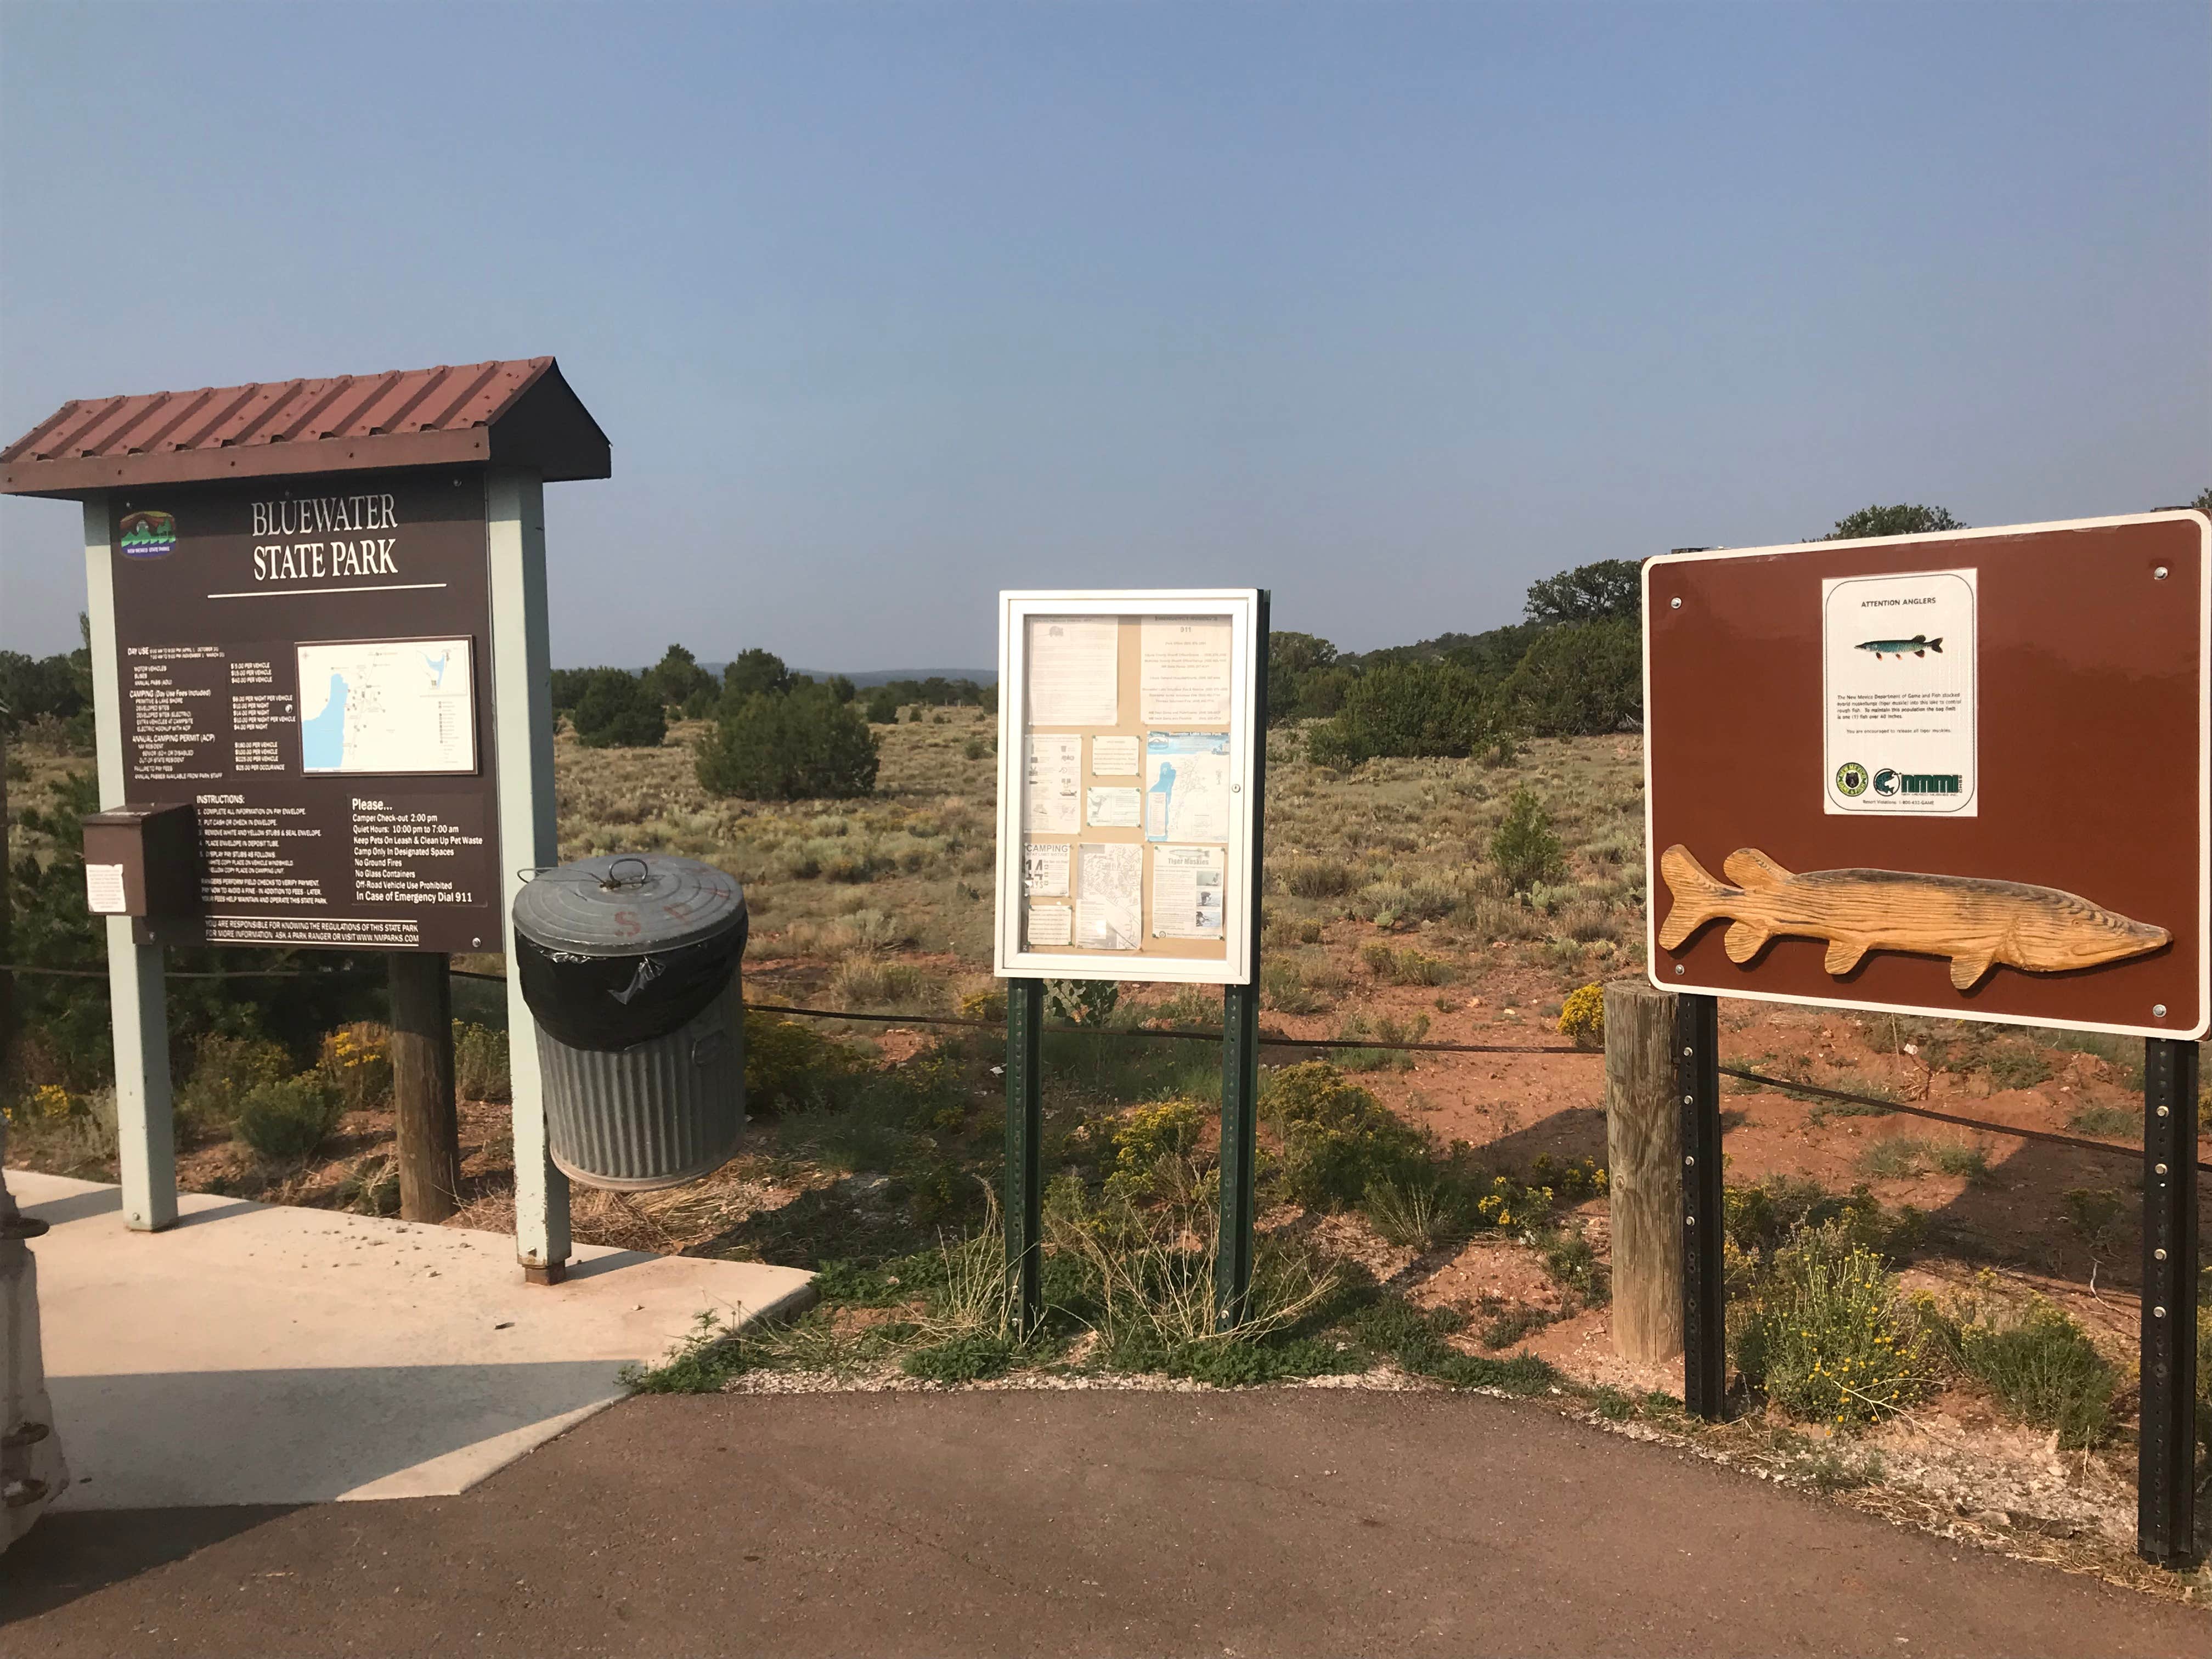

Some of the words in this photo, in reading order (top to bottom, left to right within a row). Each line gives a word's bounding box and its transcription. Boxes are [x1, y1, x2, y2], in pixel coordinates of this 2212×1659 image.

[251, 493, 398, 536] BLUEWATER
[253, 543, 325, 580] STATE
[330, 539, 398, 576] PARK
[1902, 597, 1936, 605] ANGLERS
[128, 647, 137, 656] DAY
[138, 647, 149, 655] USE
[129, 690, 154, 698] CAMPING
[196, 794, 245, 804] INSTRUCTIONS:
[352, 798, 393, 811] Please...
[353, 814, 376, 822] Camper
[377, 814, 408, 822] Check-out
[410, 814, 426, 822] 2:00
[427, 814, 438, 822] pm
[353, 825, 369, 833] Quiet
[370, 825, 390, 833] Hours:
[393, 825, 411, 833] 10:00
[413, 825, 423, 833] pm
[424, 825, 431, 833] to
[432, 825, 448, 833] 7:00
[449, 825, 459, 833] am
[354, 837, 369, 845] Keep
[370, 837, 383, 845] Pets
[384, 837, 393, 845] On
[394, 837, 412, 845] Leash
[414, 837, 419, 845] &
[420, 837, 439, 845] Clean
[440, 837, 449, 845] Up
[450, 837, 461, 845] Pet
[462, 837, 483, 845] Waste
[354, 848, 372, 856] Camp
[373, 848, 385, 856] Only
[387, 848, 393, 856] In
[394, 848, 430, 856] Designated
[430, 848, 454, 856] Spaces
[1026, 844, 1068, 853] CAMPING
[356, 870, 364, 878] No
[364, 870, 381, 878] Glass
[382, 870, 415, 878] Containers
[356, 881, 382, 889] Off-Road
[383, 881, 405, 889] Vehicle
[407, 881, 419, 889] Use
[419, 881, 452, 889] Prohibited
[357, 891, 364, 901] In
[365, 891, 384, 901] Case
[385, 891, 393, 901] of
[394, 891, 436, 904] Emergency
[438, 892, 454, 902] Dial
[455, 892, 472, 902] 911
[229, 920, 268, 929] RESPONSIBLE
[281, 921, 309, 930] KNOWING
[321, 922, 360, 931] REGULATIONS
[370, 923, 384, 932] THIS
[385, 924, 401, 932] STATE
[308, 932, 331, 940] RANGER
[341, 933, 356, 941] VISIT
